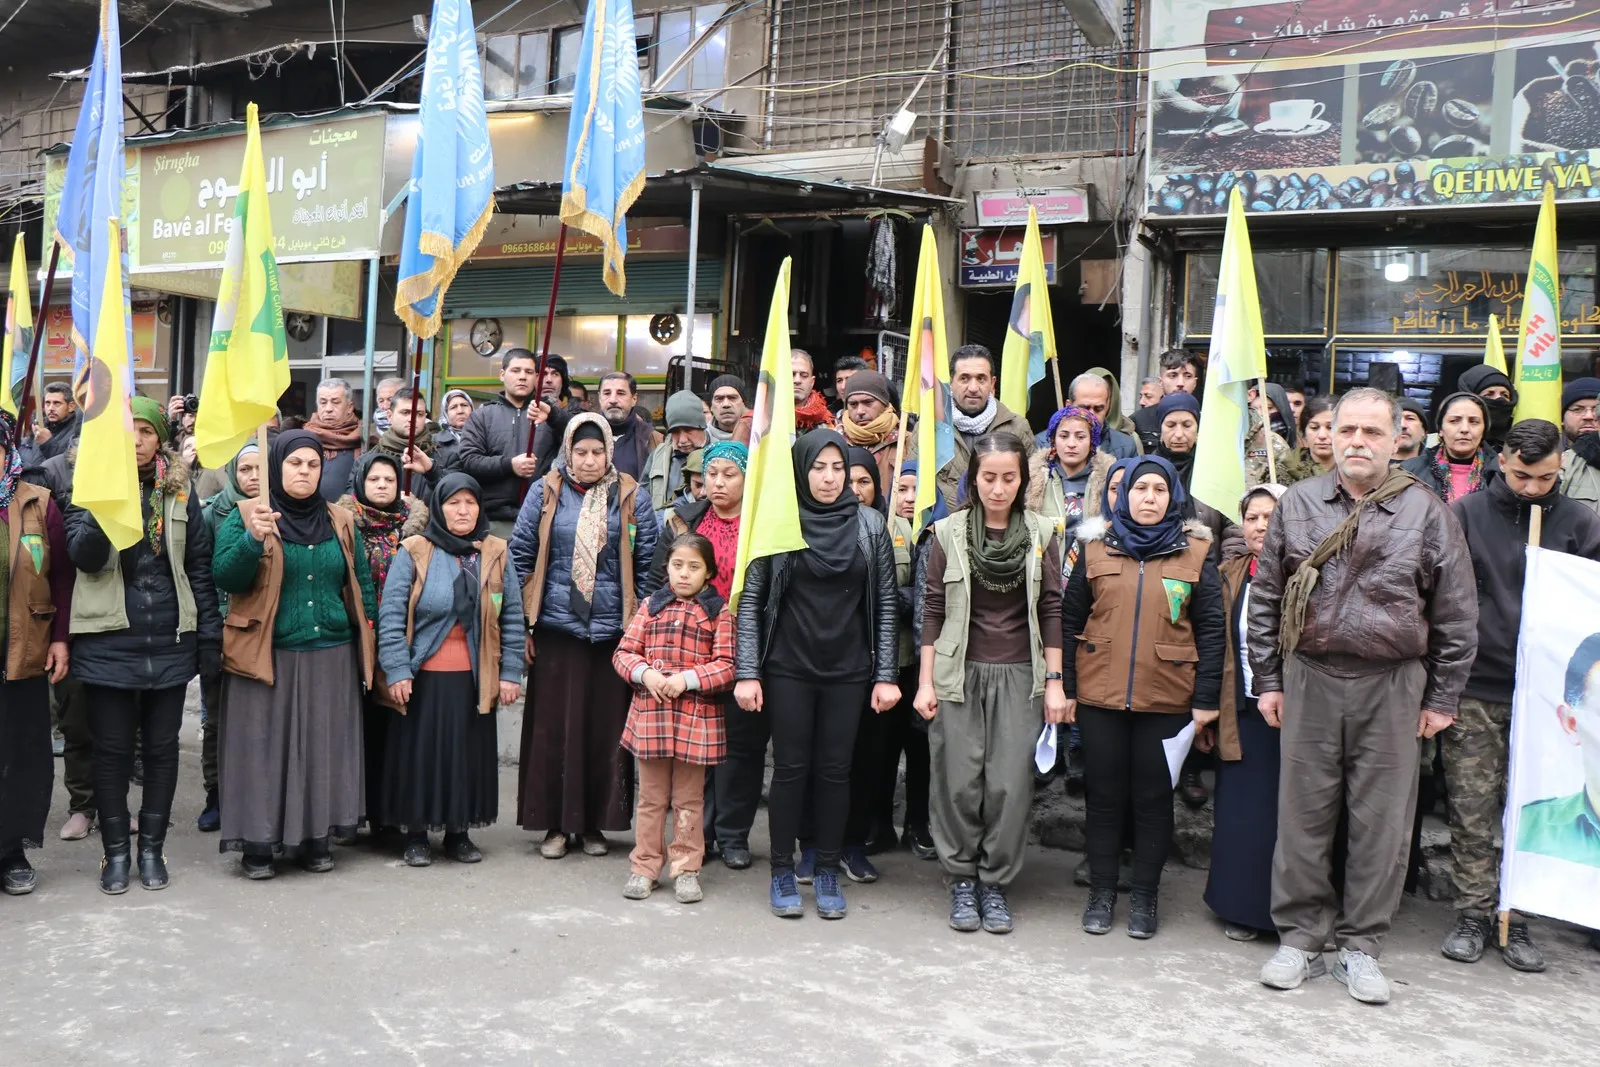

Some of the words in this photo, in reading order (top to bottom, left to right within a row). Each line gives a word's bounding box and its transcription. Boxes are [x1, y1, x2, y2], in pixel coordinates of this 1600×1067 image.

[309, 128, 358, 148] معجنات
[292, 150, 328, 201] أبو
[1433, 166, 1542, 198] QEHWE
[1552, 163, 1593, 189] YA
[152, 215, 192, 239] Bavê
[194, 213, 211, 235] al
[502, 242, 556, 254] 0966368644
